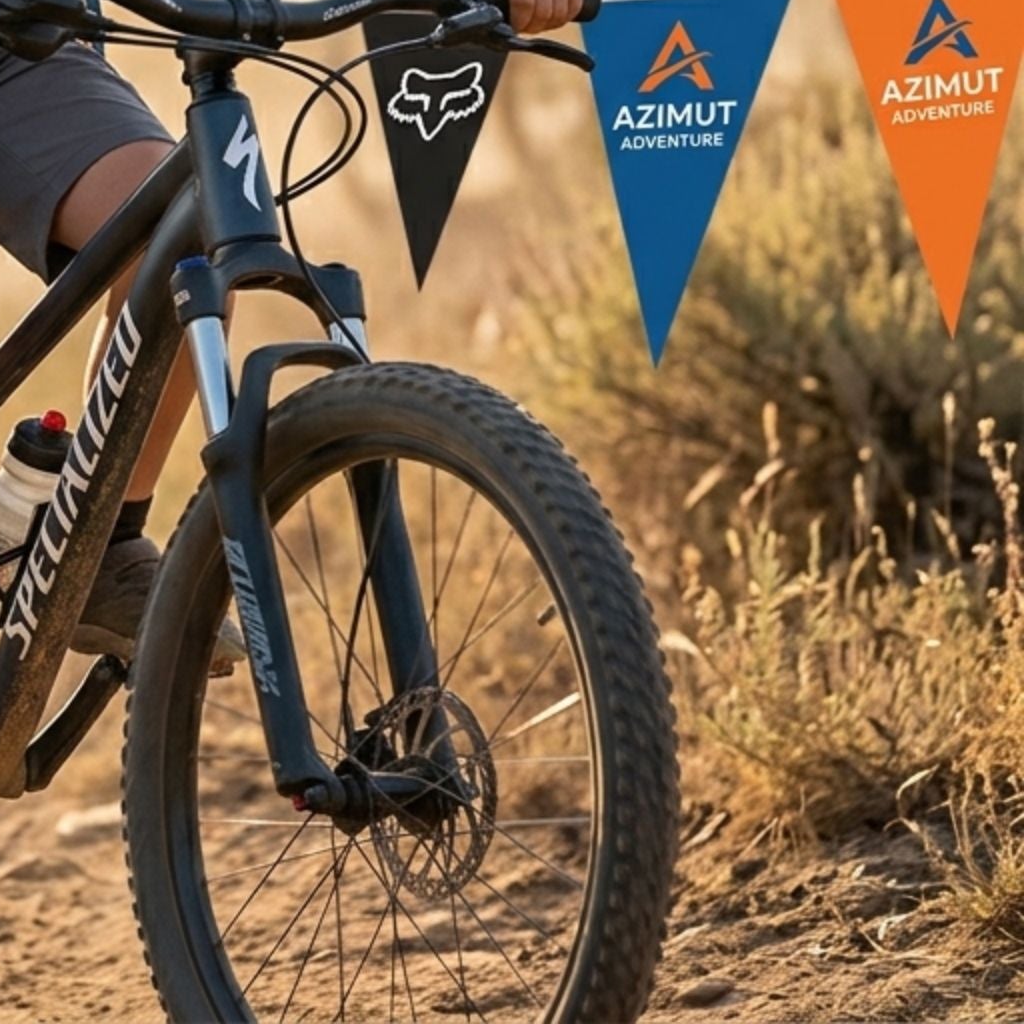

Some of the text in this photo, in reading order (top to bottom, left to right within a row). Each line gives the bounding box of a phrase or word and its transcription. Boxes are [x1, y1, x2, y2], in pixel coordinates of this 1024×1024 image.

[880, 67, 1004, 106] AZIMUT
[612, 100, 738, 131] AZIMUT
[890, 99, 995, 126] ADVENTURE
[619, 132, 725, 151] ADVENTURE
[5, 301, 143, 661] SPECIALIZED
